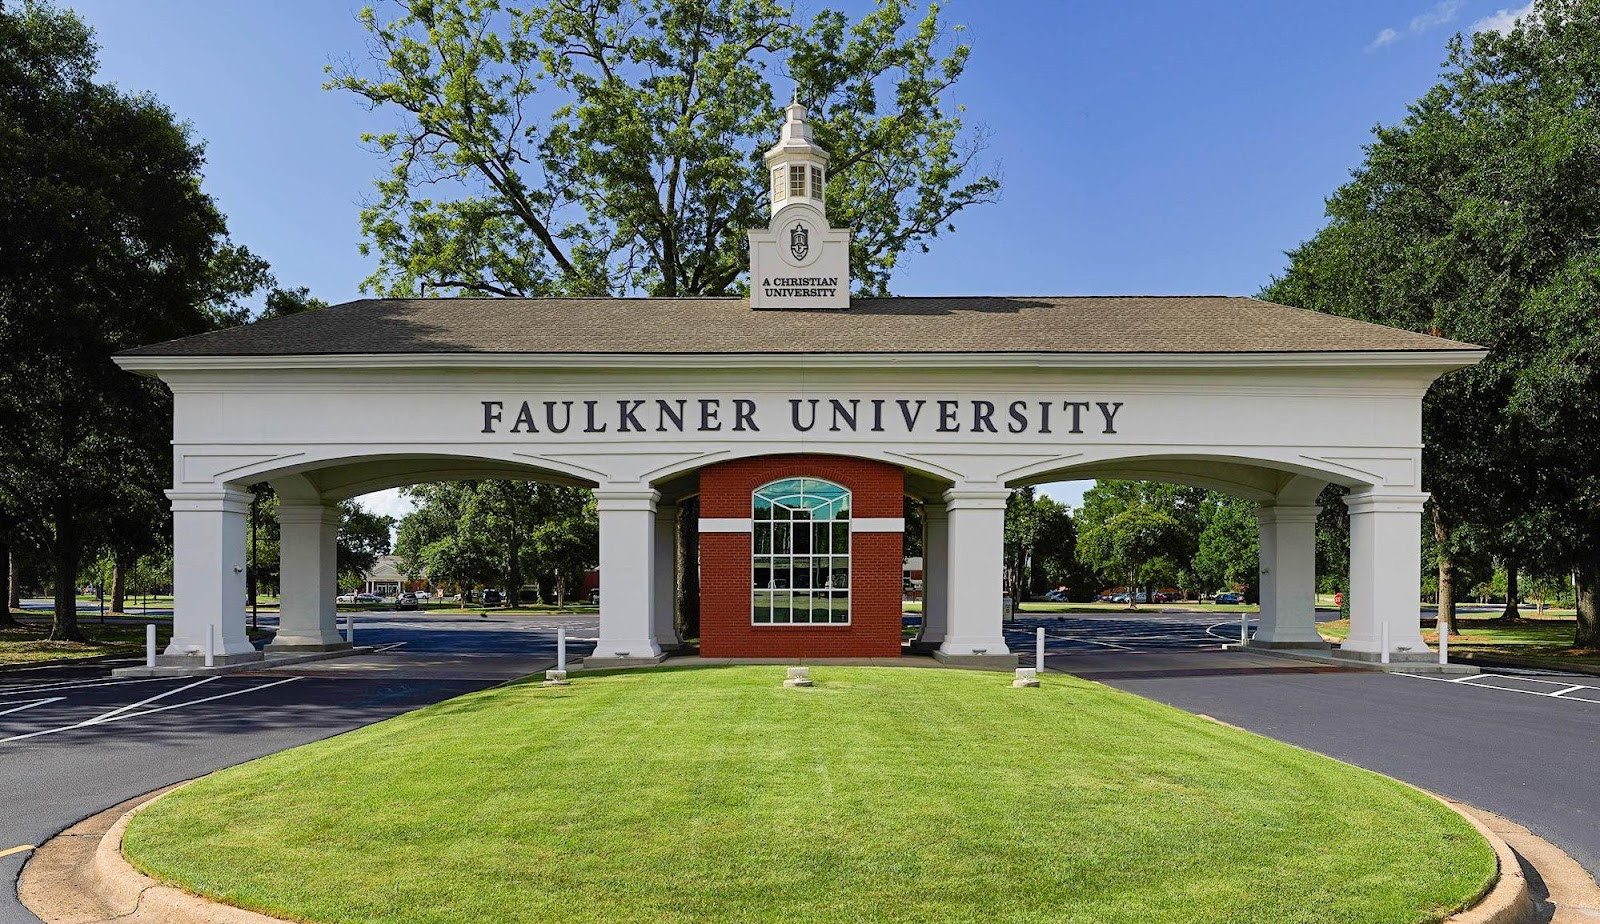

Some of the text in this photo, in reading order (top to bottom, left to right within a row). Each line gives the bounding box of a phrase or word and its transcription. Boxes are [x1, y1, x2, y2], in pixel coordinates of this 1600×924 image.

[762, 277, 838, 286] A CHRISTIAN
[765, 288, 836, 297] UNIVERSITY
[481, 399, 1123, 434] FAULKNER UNIVERSITY
